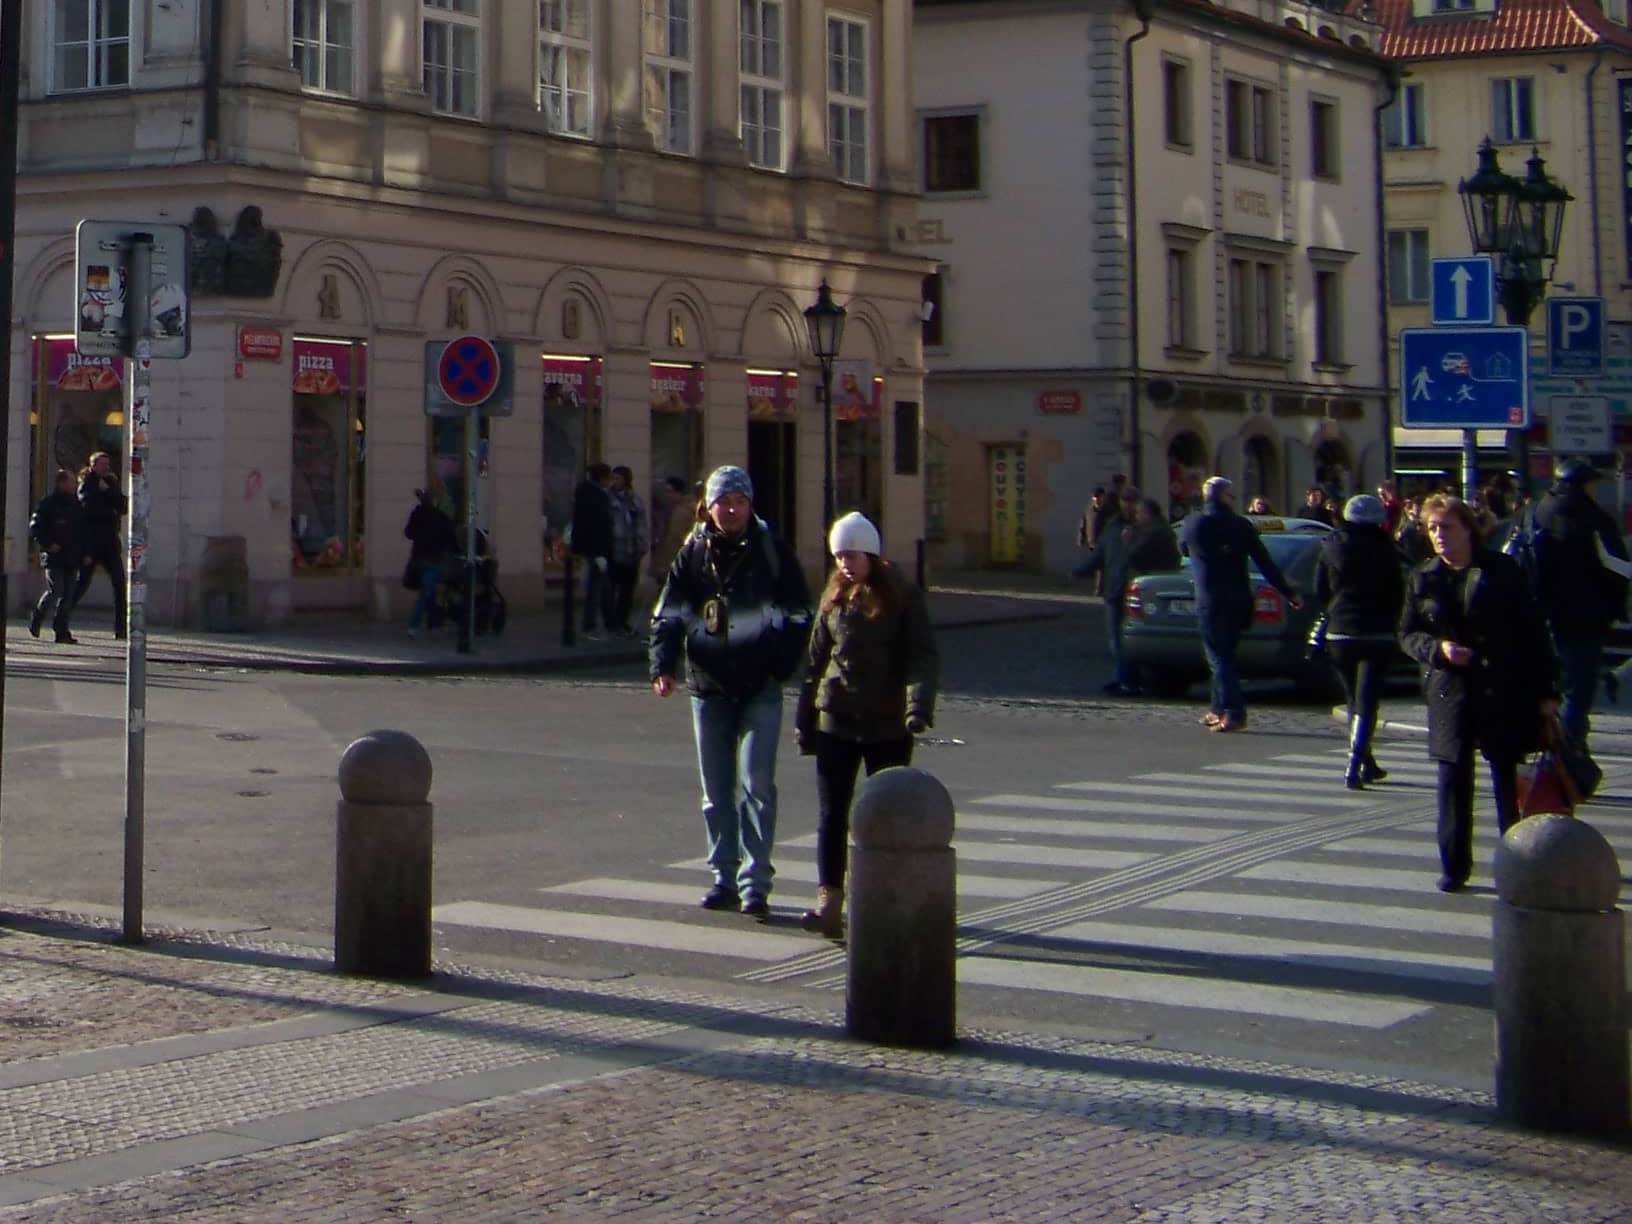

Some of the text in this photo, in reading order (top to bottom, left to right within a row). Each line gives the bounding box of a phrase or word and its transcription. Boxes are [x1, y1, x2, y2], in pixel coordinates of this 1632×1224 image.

[1233, 188, 1272, 219] HOTEL
[1560, 304, 1591, 349] P
[298, 351, 334, 371] pizza
